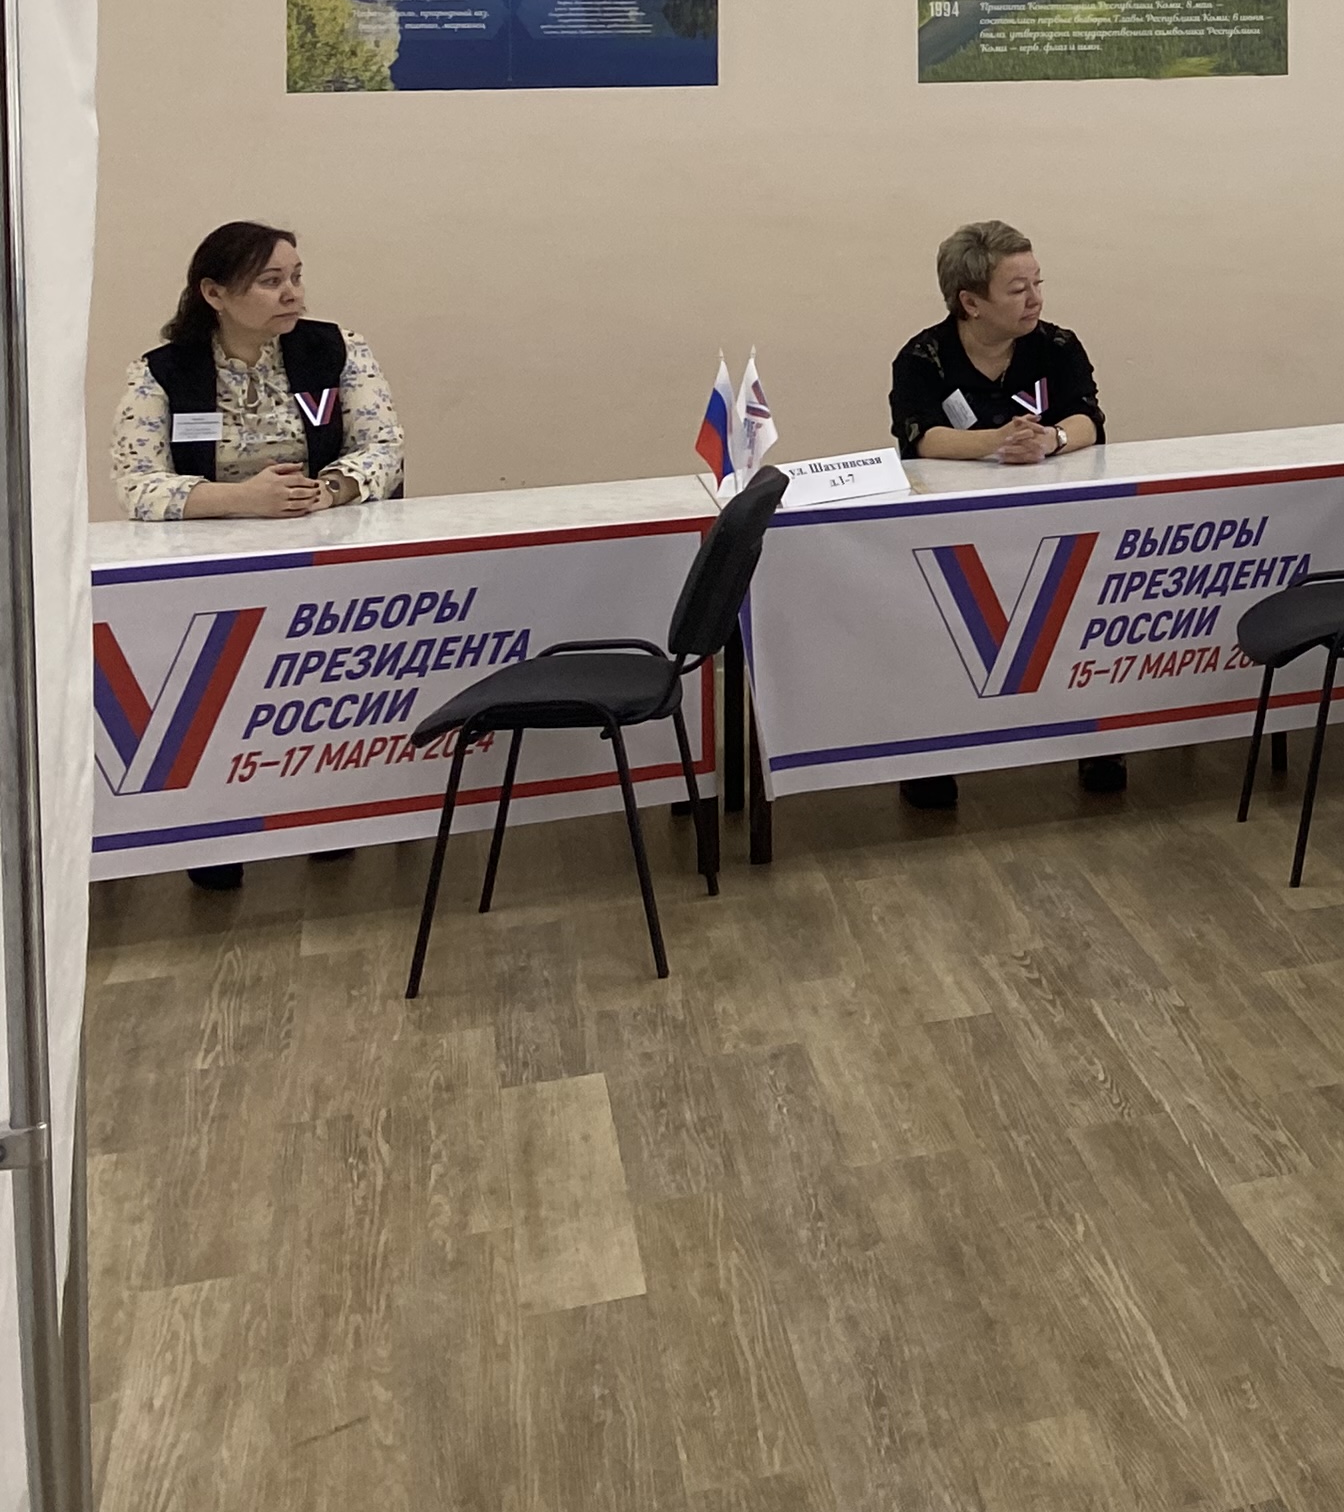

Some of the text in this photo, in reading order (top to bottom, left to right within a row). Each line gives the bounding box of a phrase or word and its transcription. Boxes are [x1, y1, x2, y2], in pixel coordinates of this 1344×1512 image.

[929, 1, 960, 17] 1994
[810, 455, 882, 474] Шахтинская
[1114, 515, 1269, 562] ВЫБОРЫ
[1097, 552, 1313, 606] ПРЕЗИДЕНТА
[286, 587, 478, 640] ВЫБОРЫ
[1079, 604, 1220, 650] РОССИИ
[264, 628, 532, 690] ПРЕЗИДЕНТА
[1137, 644, 1221, 683] МАРТА
[242, 688, 421, 739] РОССИИ
[315, 733, 416, 775] МАРТА
